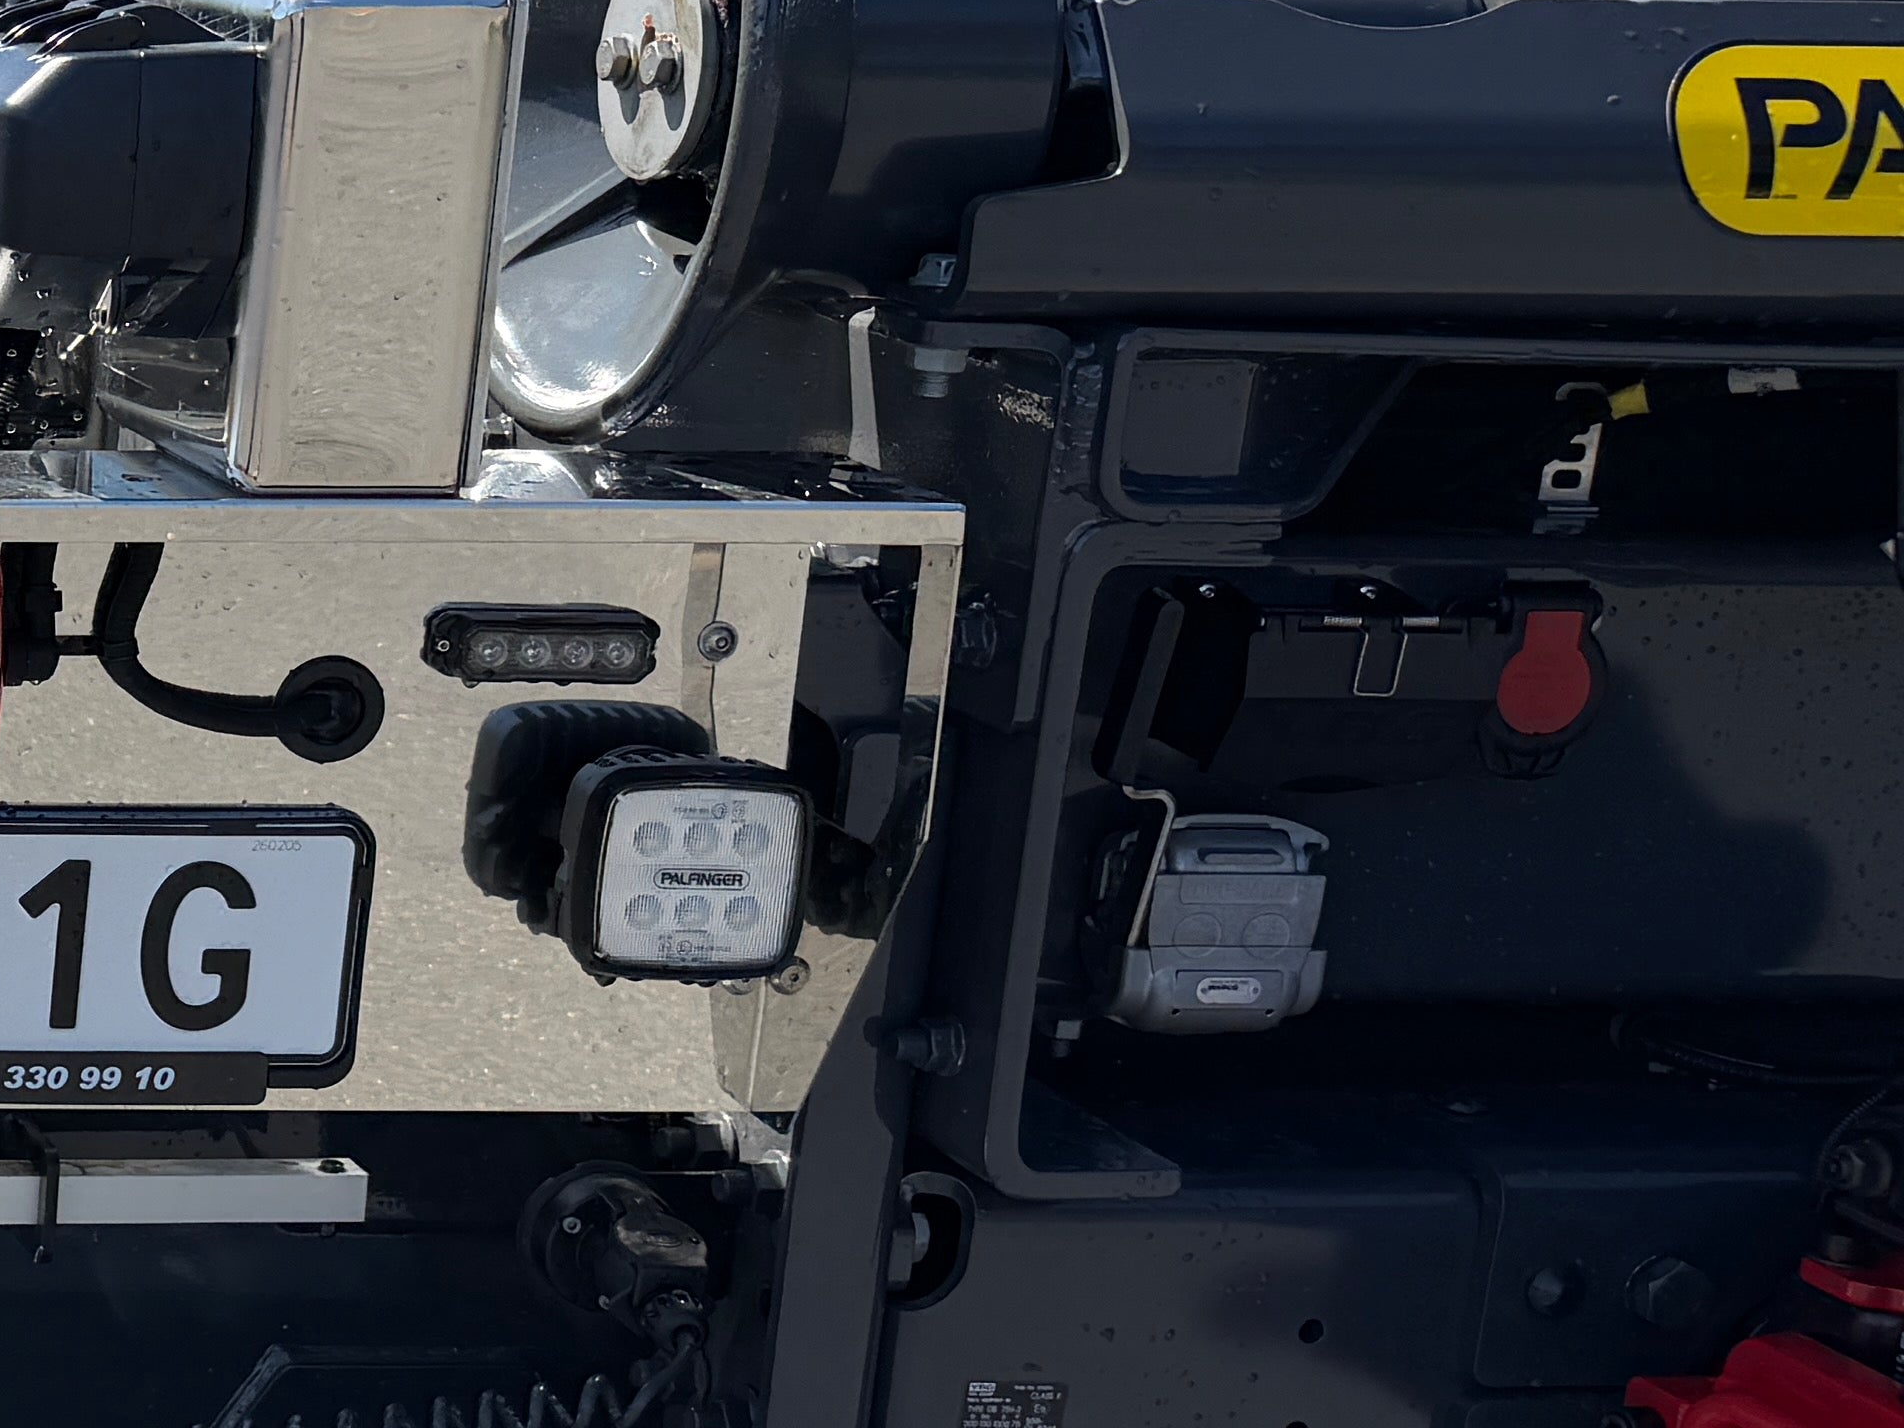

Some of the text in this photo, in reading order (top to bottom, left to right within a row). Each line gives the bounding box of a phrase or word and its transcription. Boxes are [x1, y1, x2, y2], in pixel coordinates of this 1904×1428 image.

[1734, 77, 1904, 200] PA
[3, 1065, 69, 1090] 330
[79, 1066, 122, 1090] 99
[135, 1066, 176, 1091] 10
